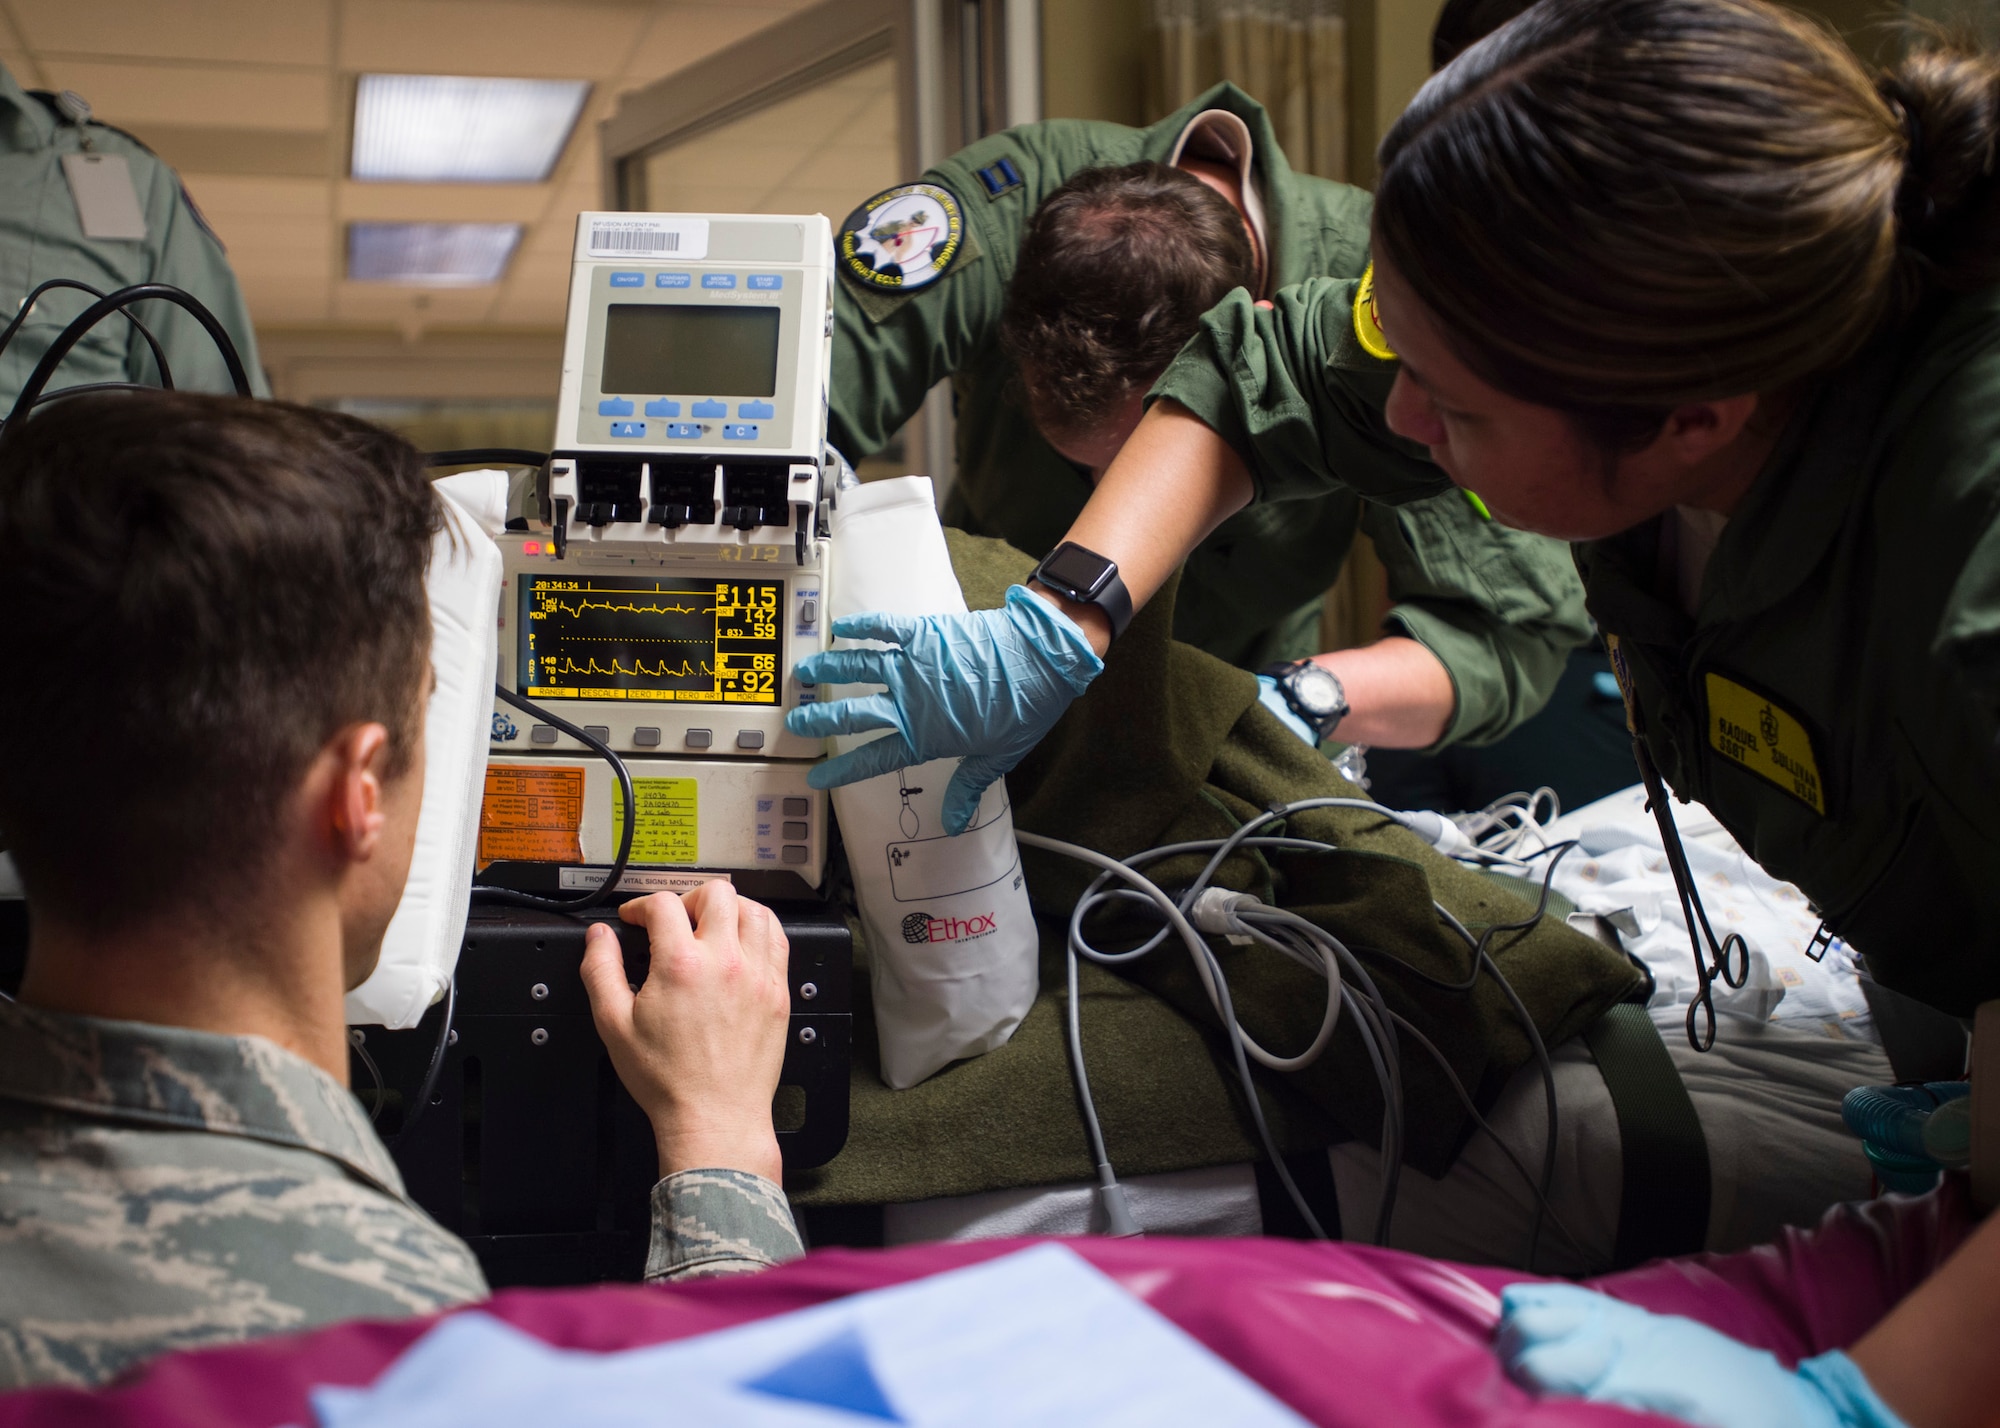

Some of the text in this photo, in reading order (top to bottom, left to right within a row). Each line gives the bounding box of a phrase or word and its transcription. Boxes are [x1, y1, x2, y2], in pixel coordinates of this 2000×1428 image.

[931, 232, 958, 271] DANGER
[875, 274, 902, 285] ECLS
[710, 290, 767, 300] MedSystem
[624, 424, 633, 434] A
[736, 427, 745, 436] C
[535, 581, 579, 589] 20:34:34
[731, 586, 776, 607] 115
[717, 608, 733, 616] ART
[745, 609, 776, 623] 147
[754, 623, 776, 637] 59
[753, 656, 775, 670] 66
[550, 676, 556, 684] 0
[743, 672, 774, 692] 92
[540, 688, 566, 696] RANGE
[582, 689, 618, 697] RESCALE
[630, 690, 651, 698] ZERO
[737, 693, 758, 701] MORE
[1719, 717, 1816, 790] RAQUEL SULLIVAN
[927, 912, 996, 943] Ethox
